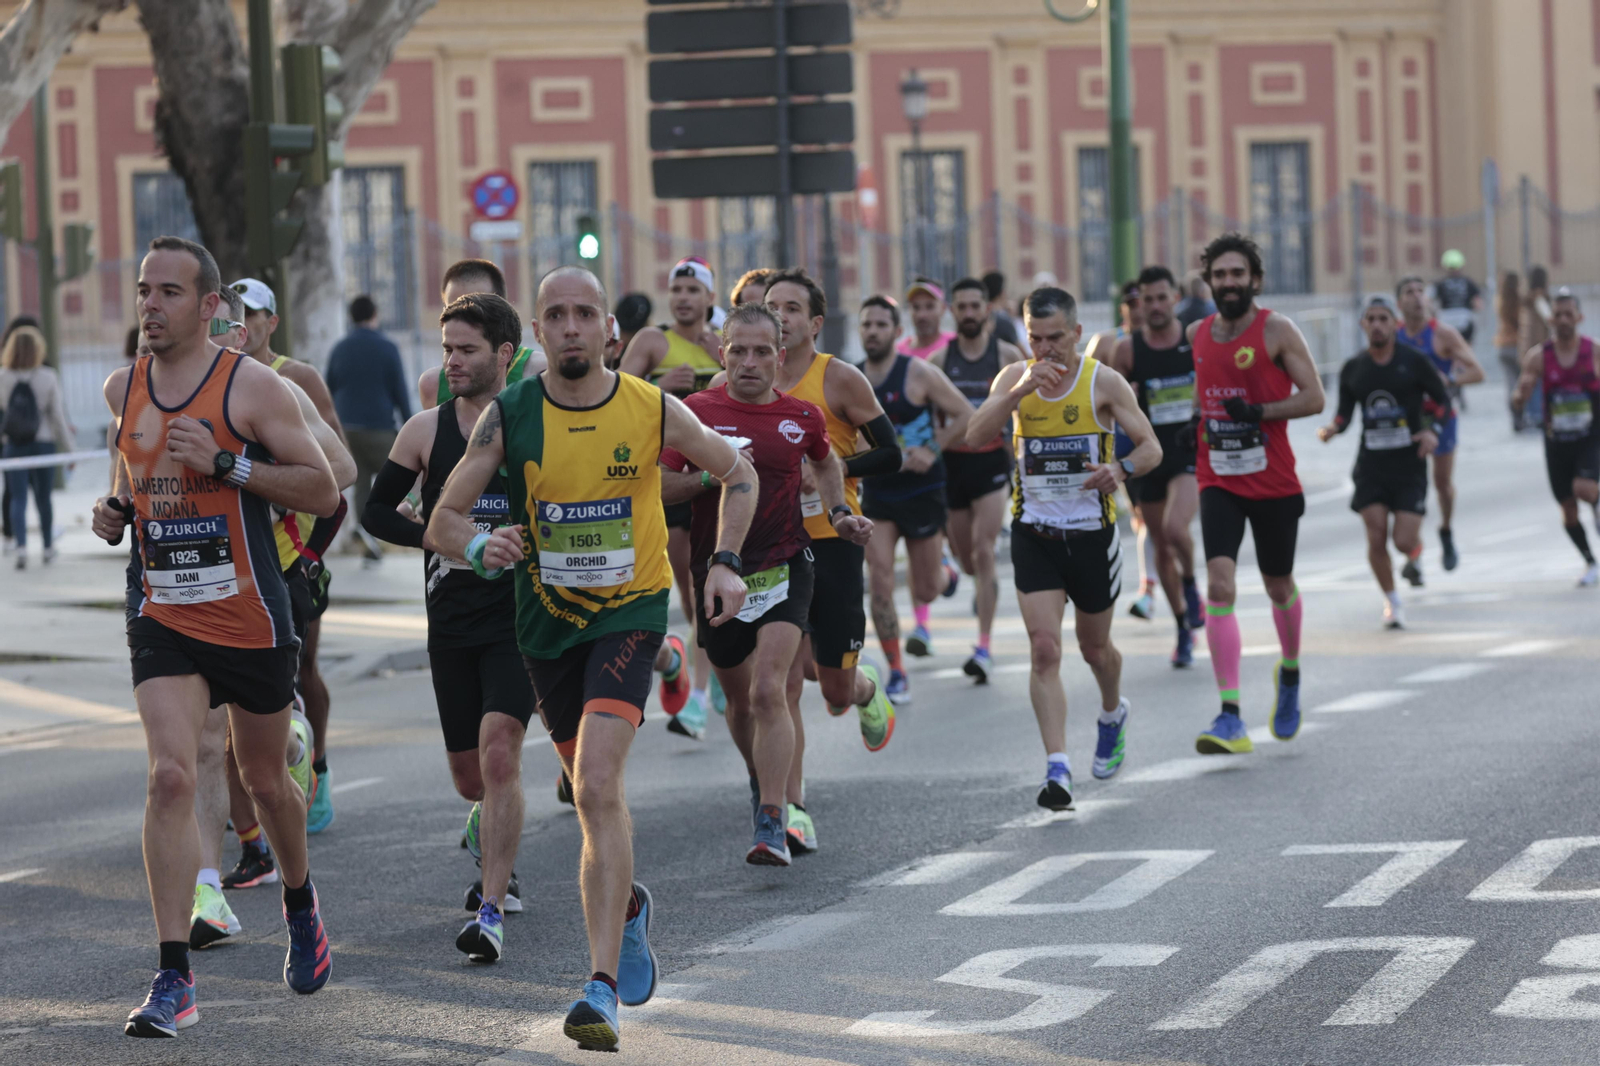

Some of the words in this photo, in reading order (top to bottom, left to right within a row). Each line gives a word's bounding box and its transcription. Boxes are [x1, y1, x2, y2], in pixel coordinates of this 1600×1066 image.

[1205, 385, 1247, 398] cicom
[1044, 440, 1082, 451] ZURICH
[607, 465, 638, 477] UDV
[1046, 477, 1069, 485] PINTO
[152, 497, 200, 519] MOAÑA
[472, 499, 509, 509] URICH
[566, 503, 622, 519] ZURICH
[165, 521, 217, 536] ZURICH
[471, 522, 491, 534] 762
[569, 533, 602, 548] 1503
[169, 550, 200, 565] 1925
[566, 555, 607, 567] ORCHID
[175, 571, 200, 584] DANI
[746, 577, 767, 589] 1162
